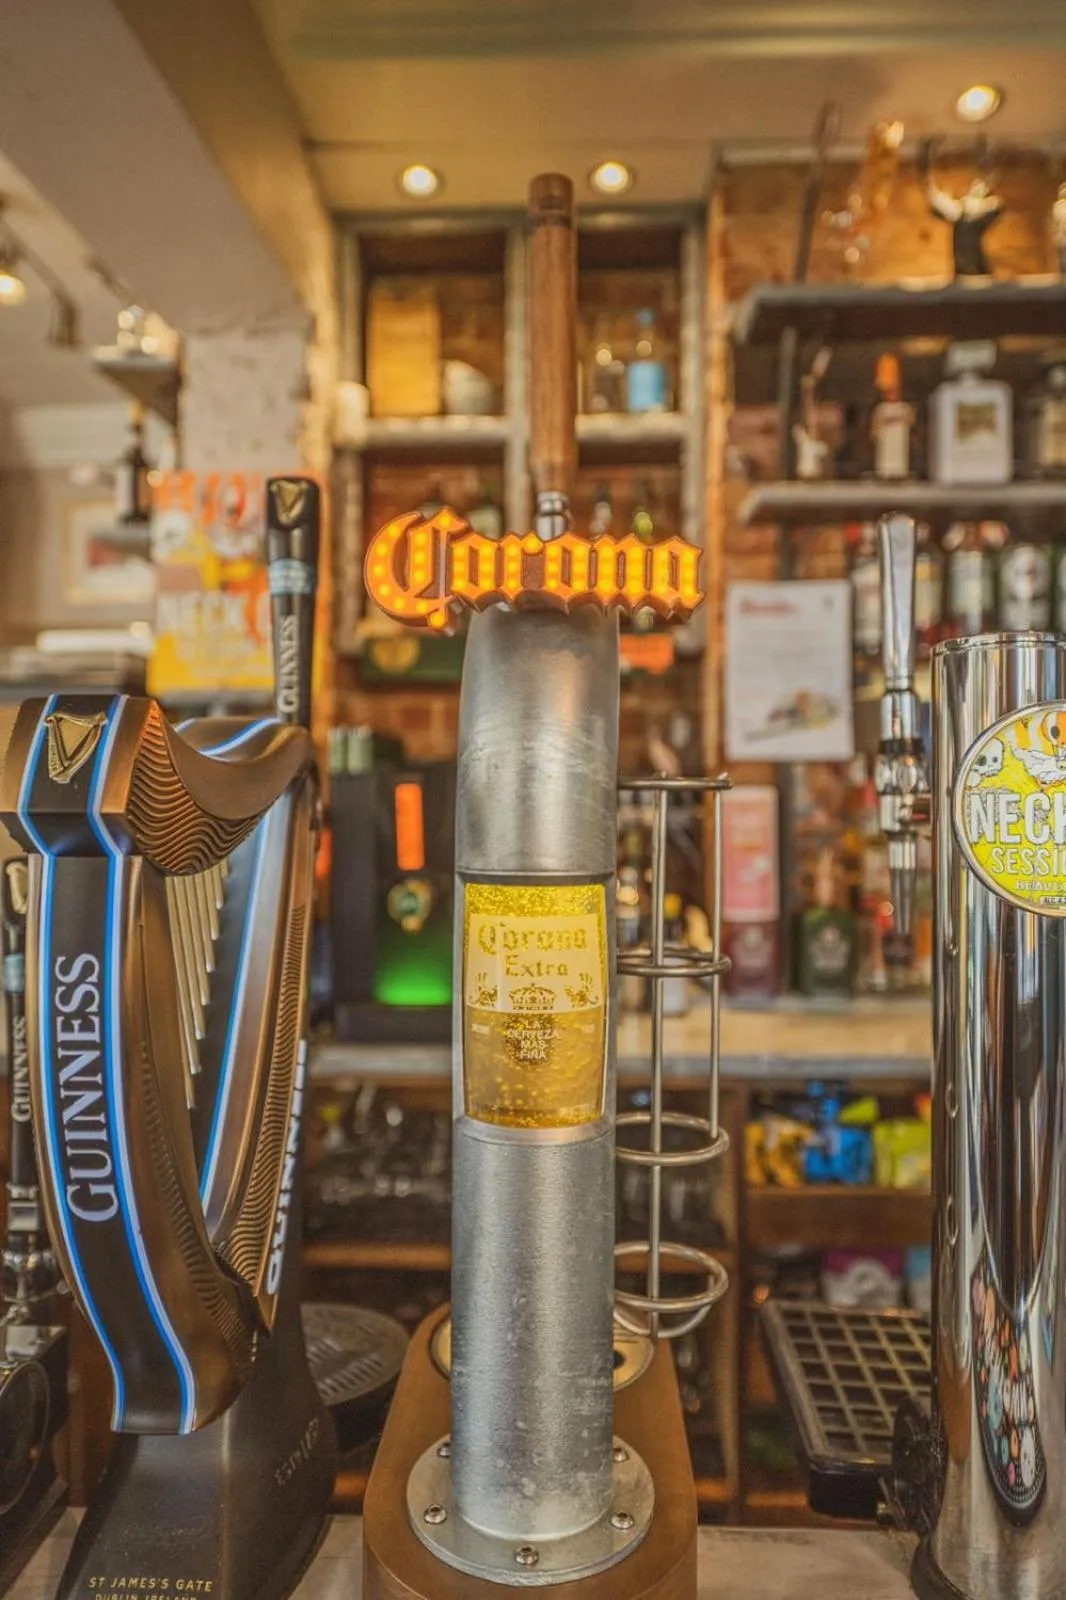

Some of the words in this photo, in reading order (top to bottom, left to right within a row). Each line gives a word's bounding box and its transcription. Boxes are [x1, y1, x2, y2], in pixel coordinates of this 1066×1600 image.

[364, 506, 705, 630] Corona
[478, 921, 589, 956] Corona
[504, 954, 568, 977] Extra
[507, 1029, 560, 1039] CERVEZA
[11, 1016, 32, 1123] GUINNESS
[54, 952, 121, 1222] GUINNESS
[88, 1577, 105, 1588] ST
[111, 1577, 169, 1589] JAMES'S
[175, 1580, 213, 1592] GATE
